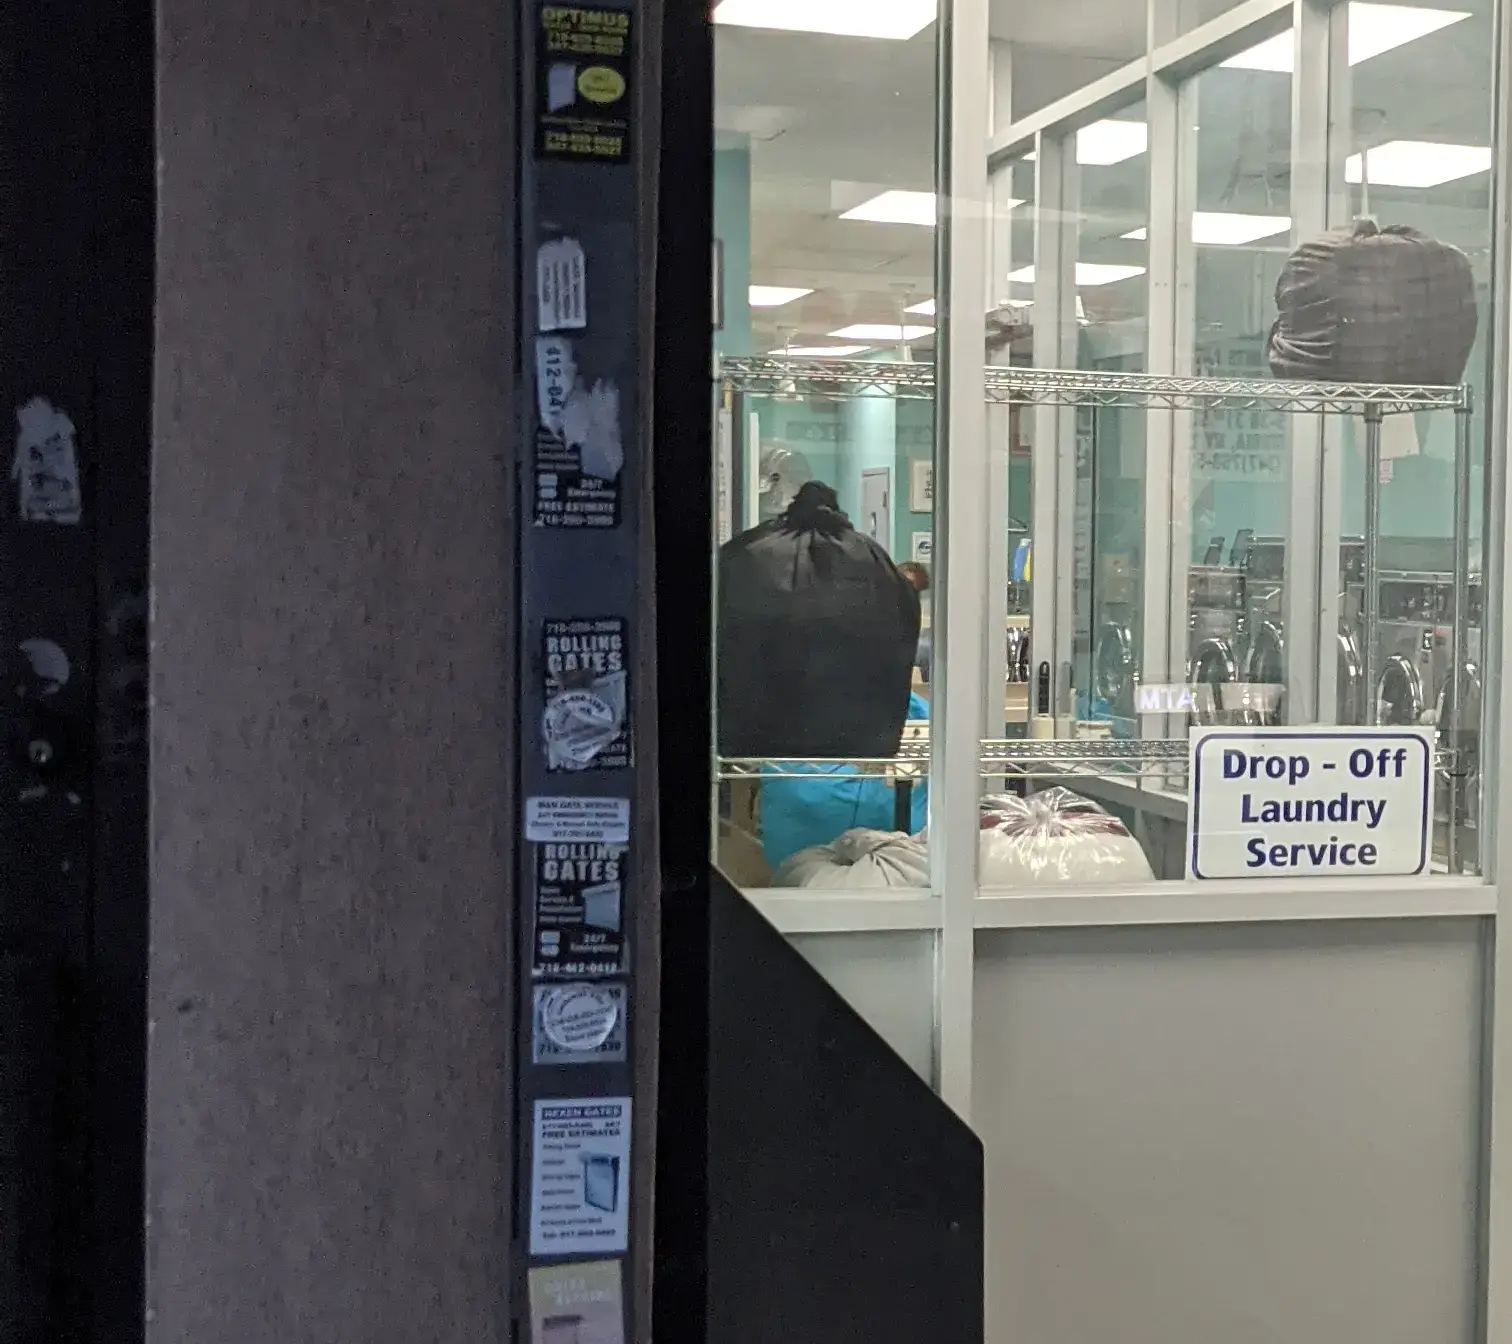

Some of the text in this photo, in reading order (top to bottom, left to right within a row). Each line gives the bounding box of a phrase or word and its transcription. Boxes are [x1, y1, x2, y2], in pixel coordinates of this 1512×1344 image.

[546, 635, 622, 652] ROLLING
[548, 652, 622, 674] GATES
[1222, 748, 1310, 785] Drop
[1349, 747, 1407, 778] Off
[1241, 792, 1387, 828] Laundry
[544, 843, 620, 860] ROLLING
[1246, 836, 1378, 868] Service
[543, 860, 619, 882] GATES
